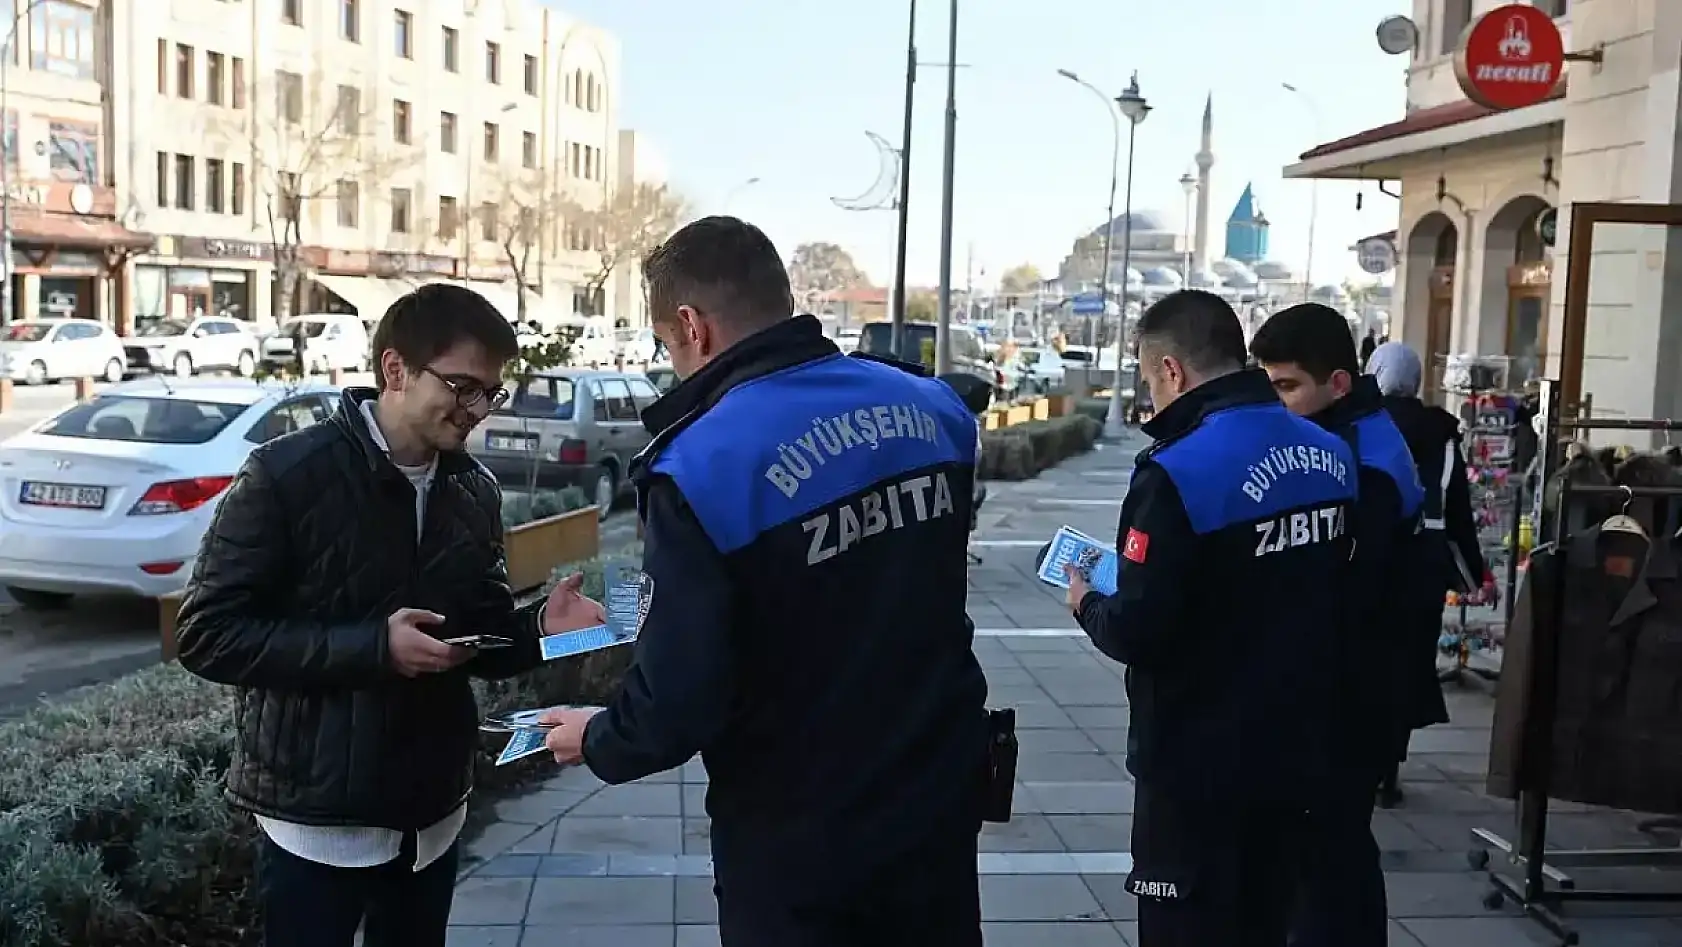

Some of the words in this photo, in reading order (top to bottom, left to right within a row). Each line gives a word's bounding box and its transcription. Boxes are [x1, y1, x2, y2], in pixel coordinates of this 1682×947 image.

[1476, 62, 1552, 84] necati
[765, 403, 938, 498] BÜYÜKŞEHİR
[802, 472, 953, 566] ZABITA
[1255, 505, 1344, 557] ZABITA
[1133, 880, 1178, 898] ZABITA
